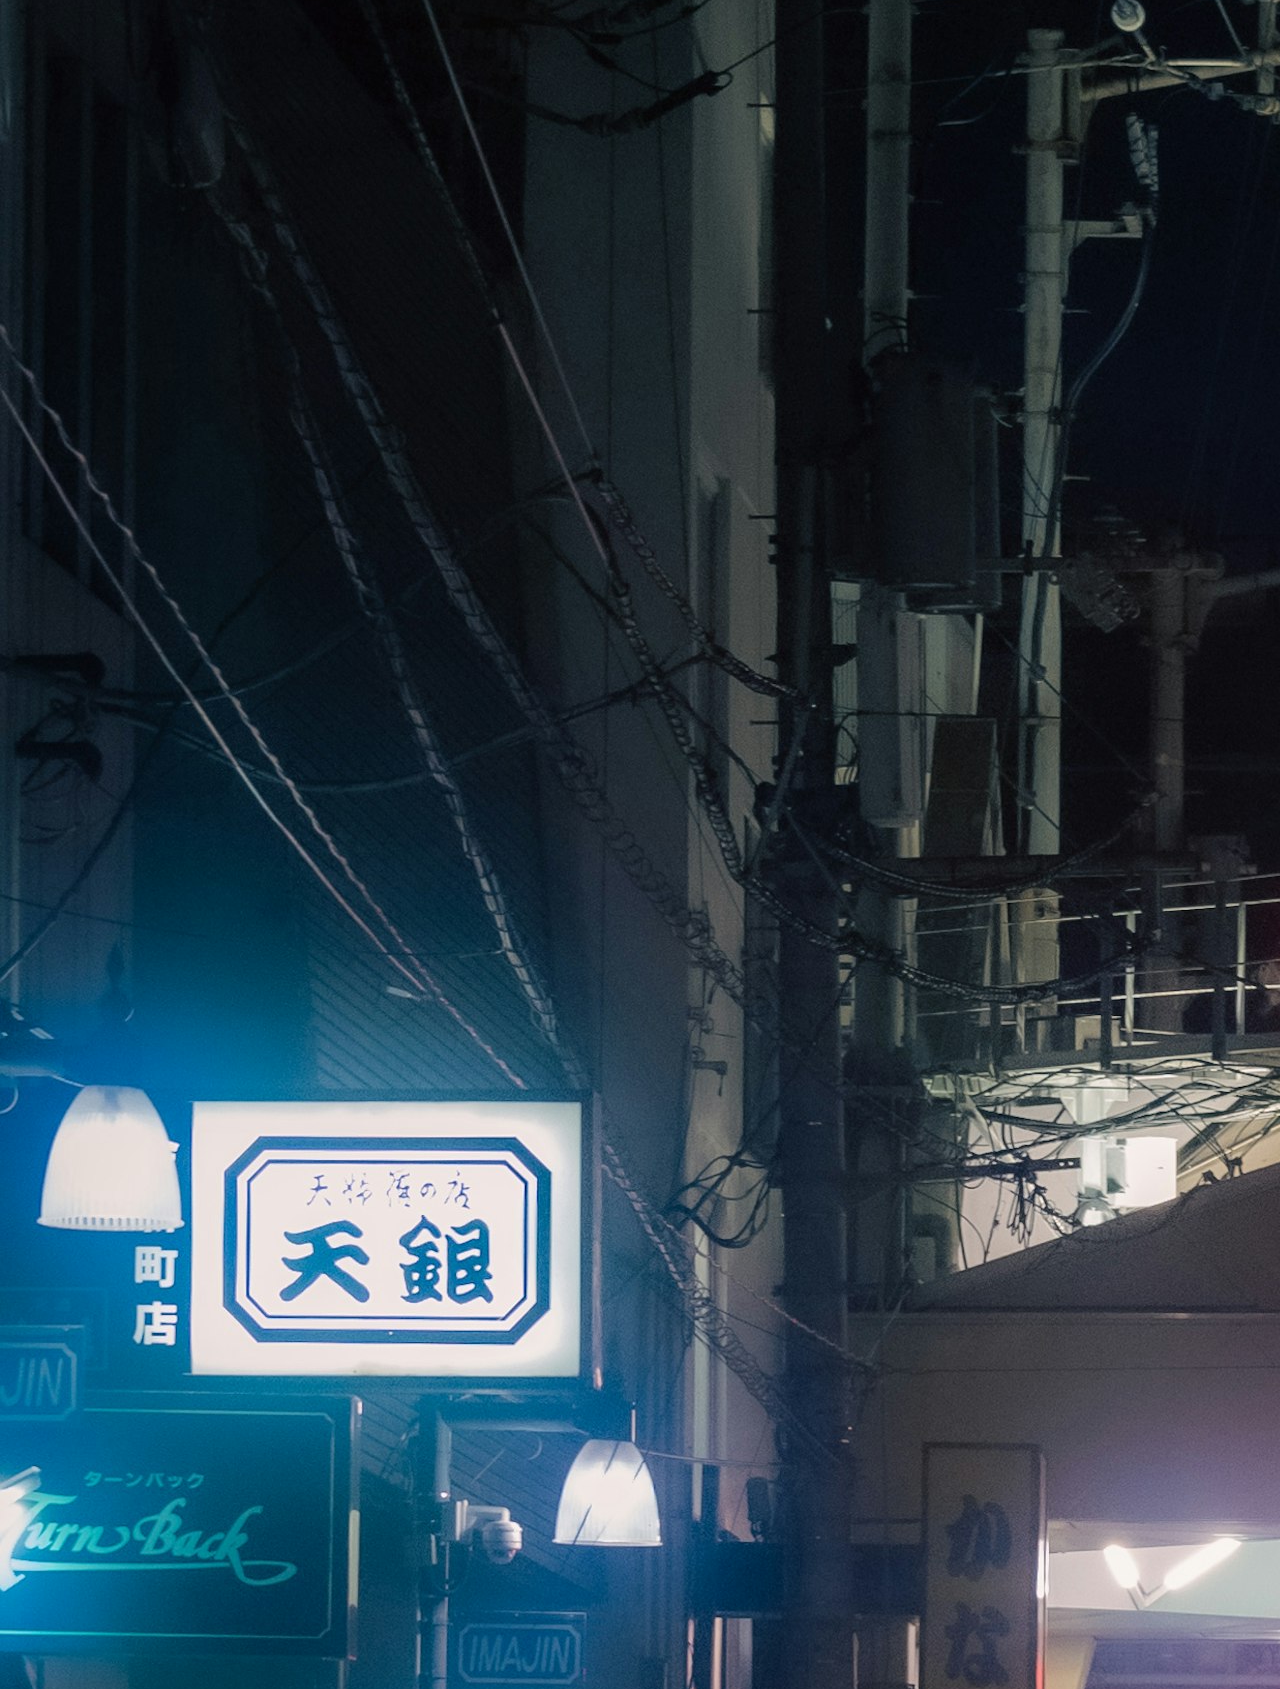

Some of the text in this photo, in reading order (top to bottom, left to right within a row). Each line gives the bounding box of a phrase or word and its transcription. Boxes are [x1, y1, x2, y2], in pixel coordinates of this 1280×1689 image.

[134, 1226, 179, 1347] 町店
[279, 1215, 494, 1305] 天銀
[83, 1470, 205, 1489] ターンバック
[134, 1497, 278, 1575] Back
[469, 1636, 572, 1674] IMAJIN
